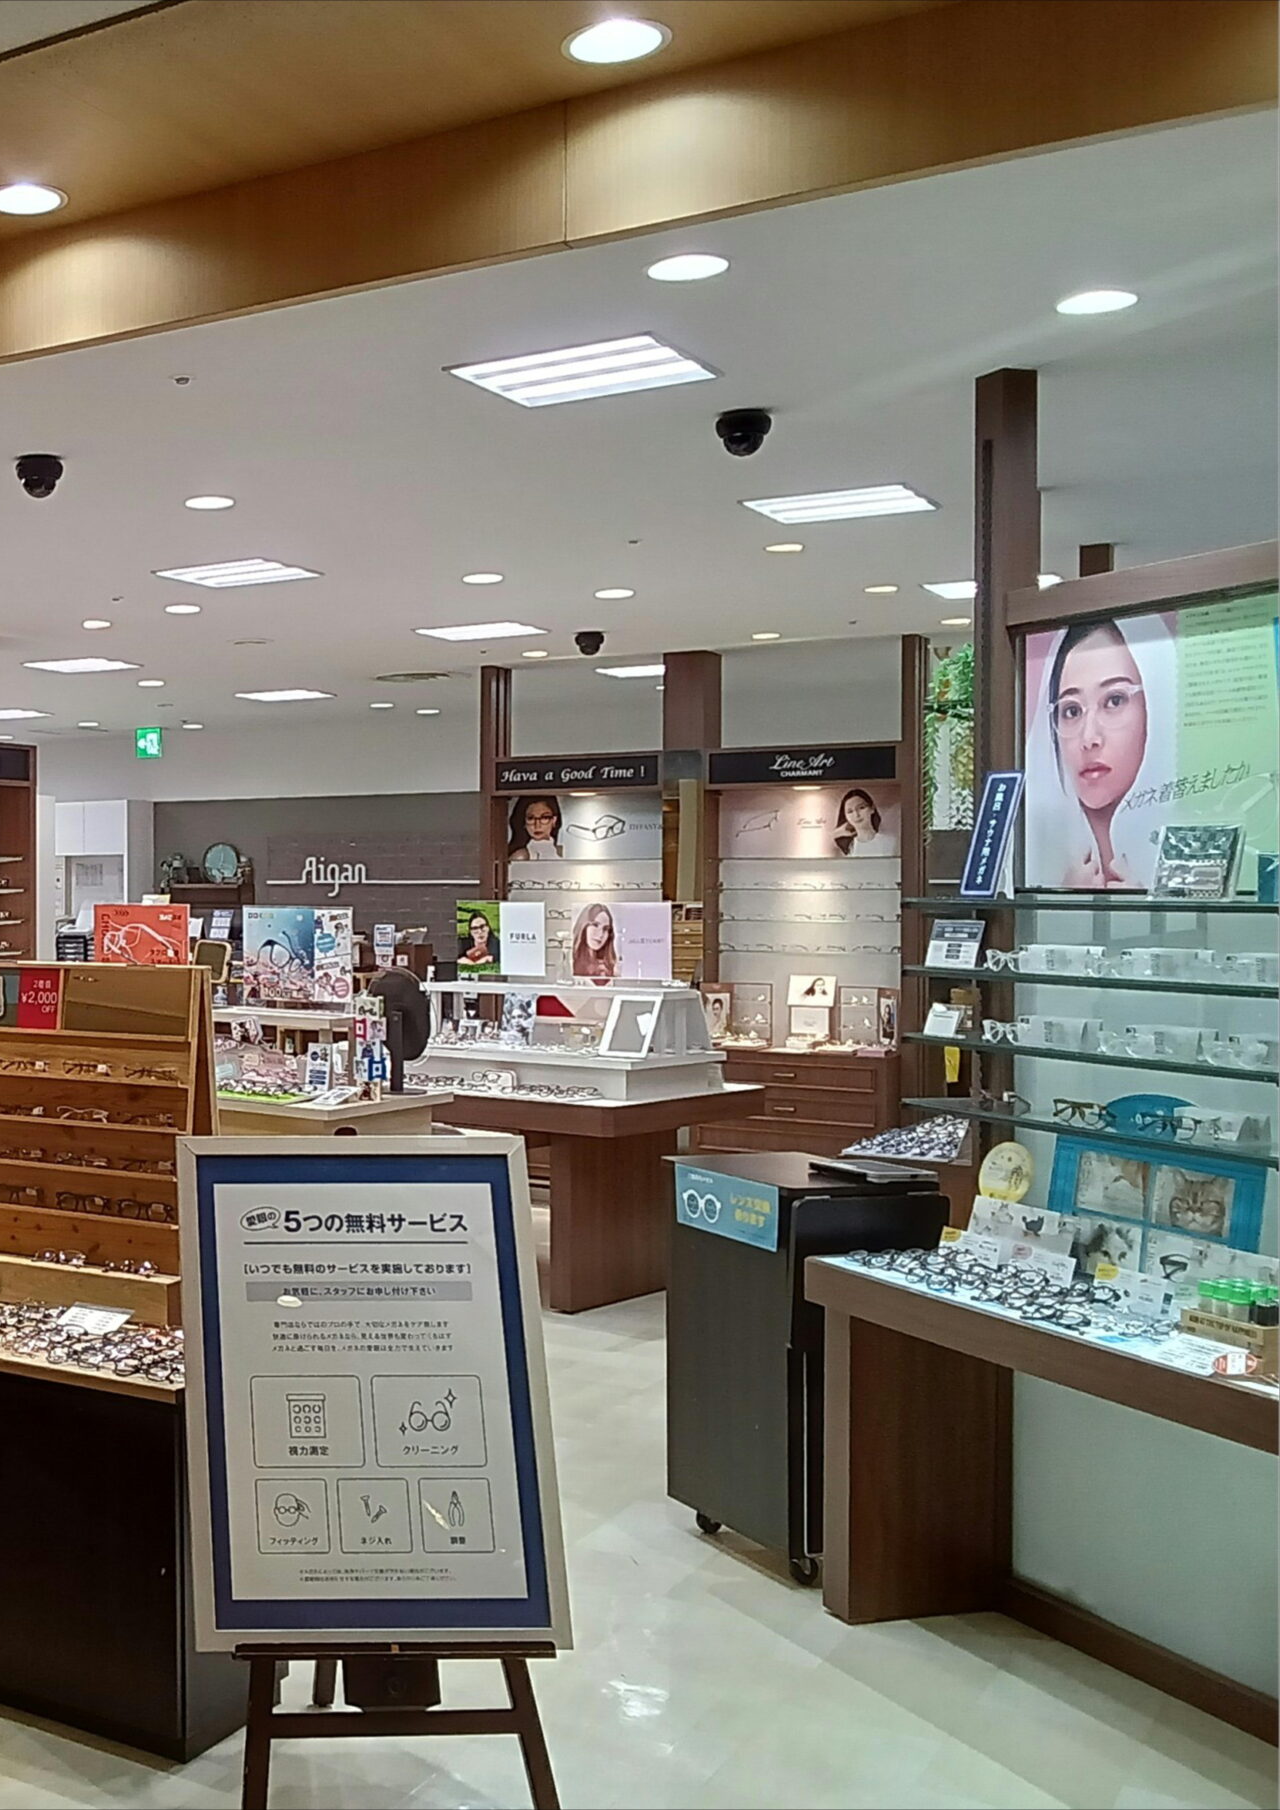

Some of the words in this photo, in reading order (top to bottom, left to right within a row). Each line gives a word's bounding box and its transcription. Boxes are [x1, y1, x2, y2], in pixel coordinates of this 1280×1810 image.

[769, 754, 804, 770] Line
[802, 753, 836, 769] Art
[500, 768, 538, 783] Hava
[544, 772, 554, 781] a
[561, 766, 597, 782] Good
[599, 765, 634, 779] Time
[780, 769, 824, 778] CHARMANT
[302, 857, 366, 897] Aigan
[509, 932, 537, 941] FURLA
[21, 991, 58, 1005] ¥2,000
[41, 1004, 56, 1013] OFF
[283, 1210, 469, 1234] 5つの無料サービス
[288, 1445, 330, 1456] 視力測定
[402, 1445, 459, 1456] クリーニング
[269, 1536, 318, 1546] フィッティング
[360, 1536, 392, 1545] ネジ入れ
[450, 1536, 466, 1545] 調整
